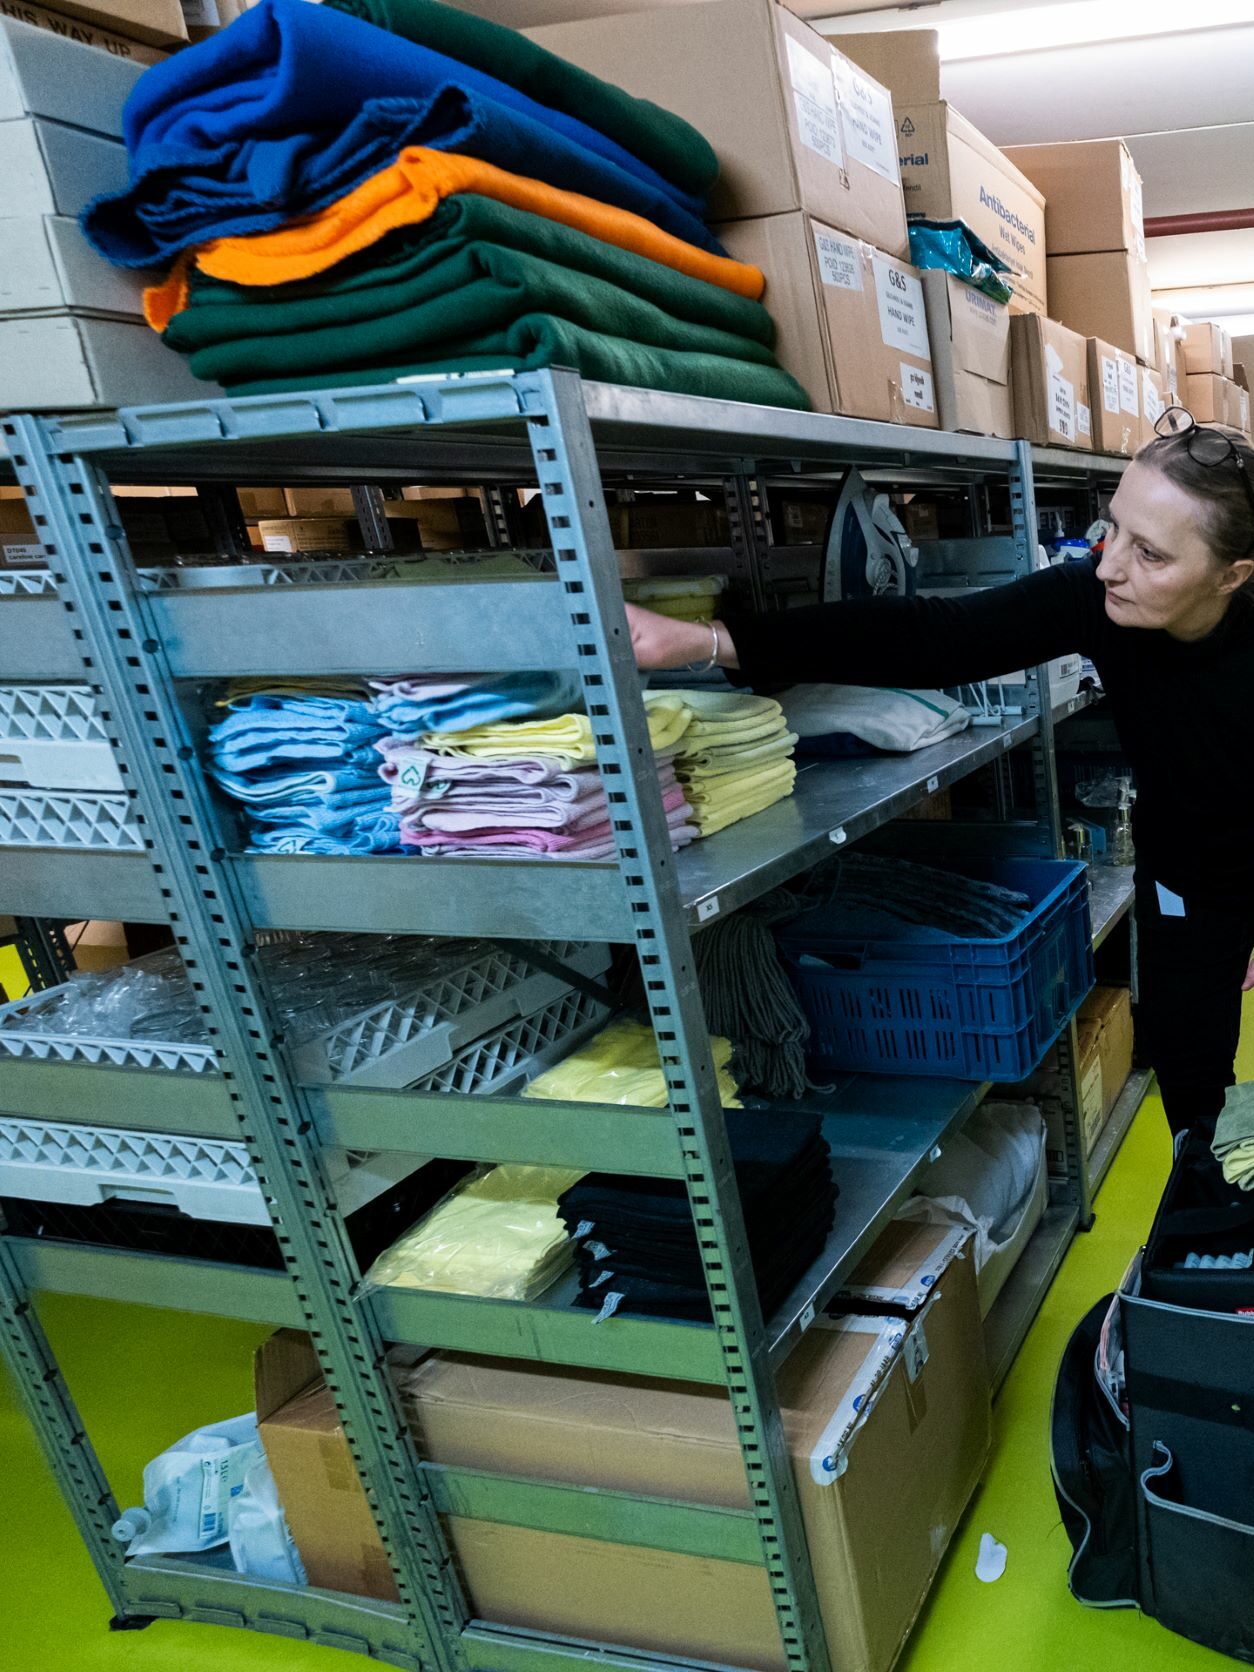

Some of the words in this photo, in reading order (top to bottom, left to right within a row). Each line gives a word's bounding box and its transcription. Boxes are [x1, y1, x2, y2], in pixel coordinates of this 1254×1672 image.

[1, 0, 39, 27] HIS
[979, 185, 1036, 246] Antibacterial
[888, 268, 907, 292] G&S
[887, 305, 903, 321] HAND
[902, 312, 915, 327] WIPE
